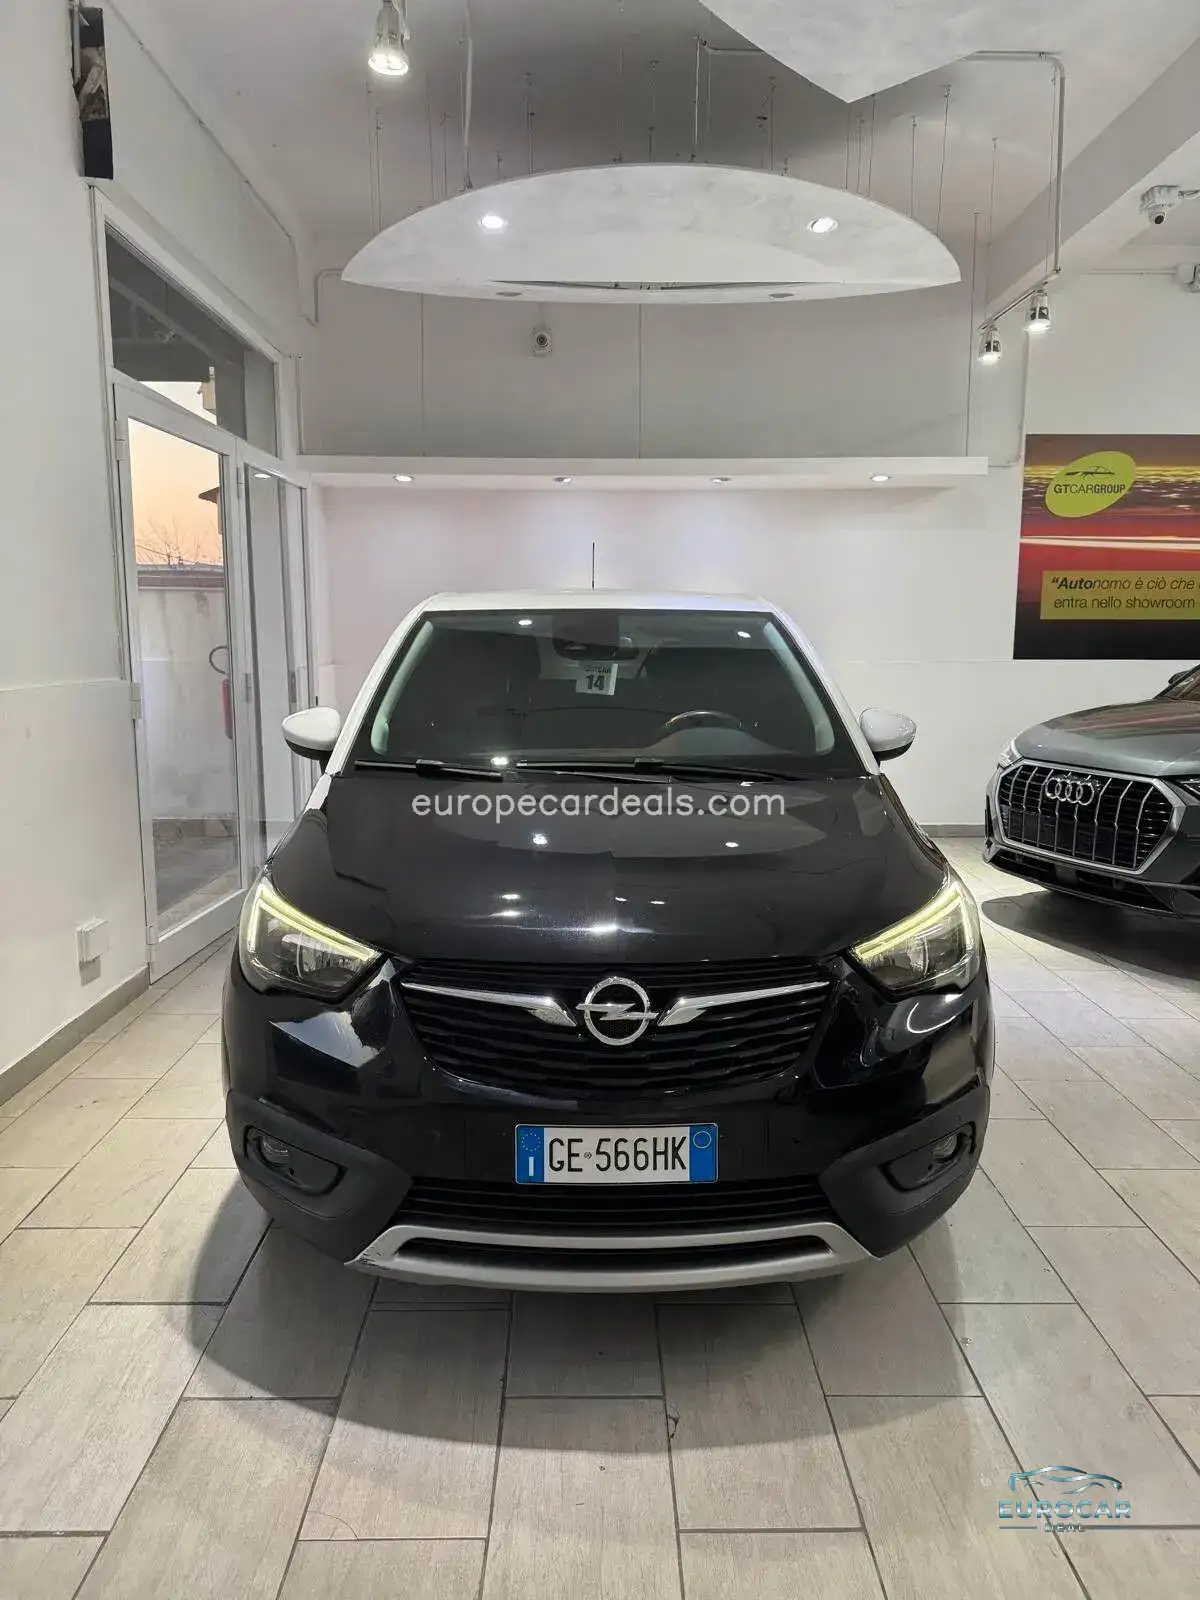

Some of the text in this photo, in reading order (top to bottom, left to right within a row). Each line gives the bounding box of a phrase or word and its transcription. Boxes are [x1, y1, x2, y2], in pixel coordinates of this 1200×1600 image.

[1053, 483, 1126, 494] GTCARGROUP
[1134, 576, 1145, 590] è
[1146, 576, 1167, 590] ciò
[1169, 576, 1196, 590] che
[1053, 596, 1196, 609] entra nello showroom
[548, 1135, 687, 1173] GE 566HK
